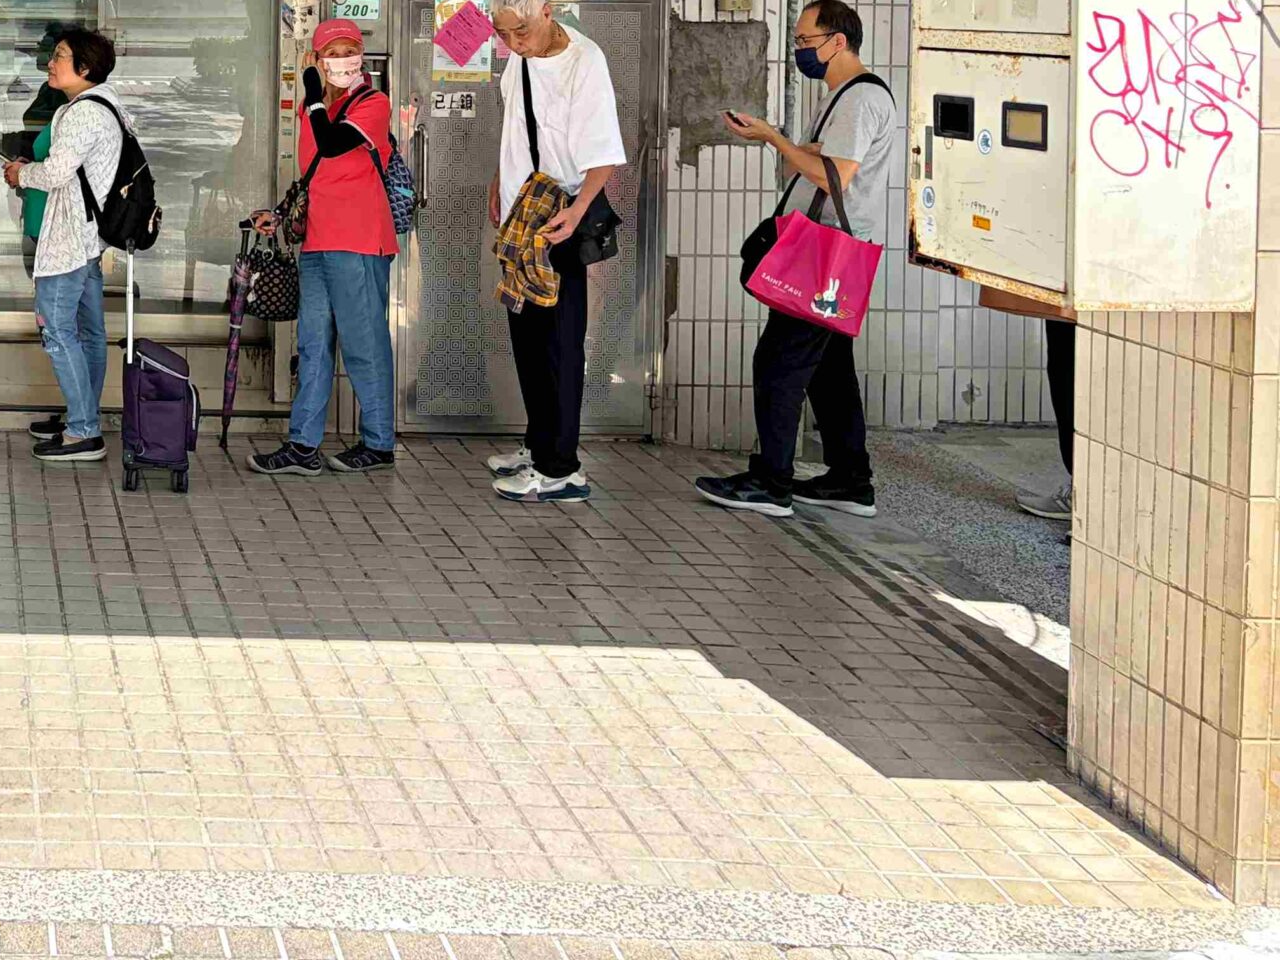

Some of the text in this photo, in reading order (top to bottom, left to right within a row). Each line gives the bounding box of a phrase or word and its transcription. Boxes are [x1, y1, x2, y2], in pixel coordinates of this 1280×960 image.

[343, 5, 369, 17] 200
[761, 272, 783, 287] SAINT
[783, 284, 803, 298] PAUL
